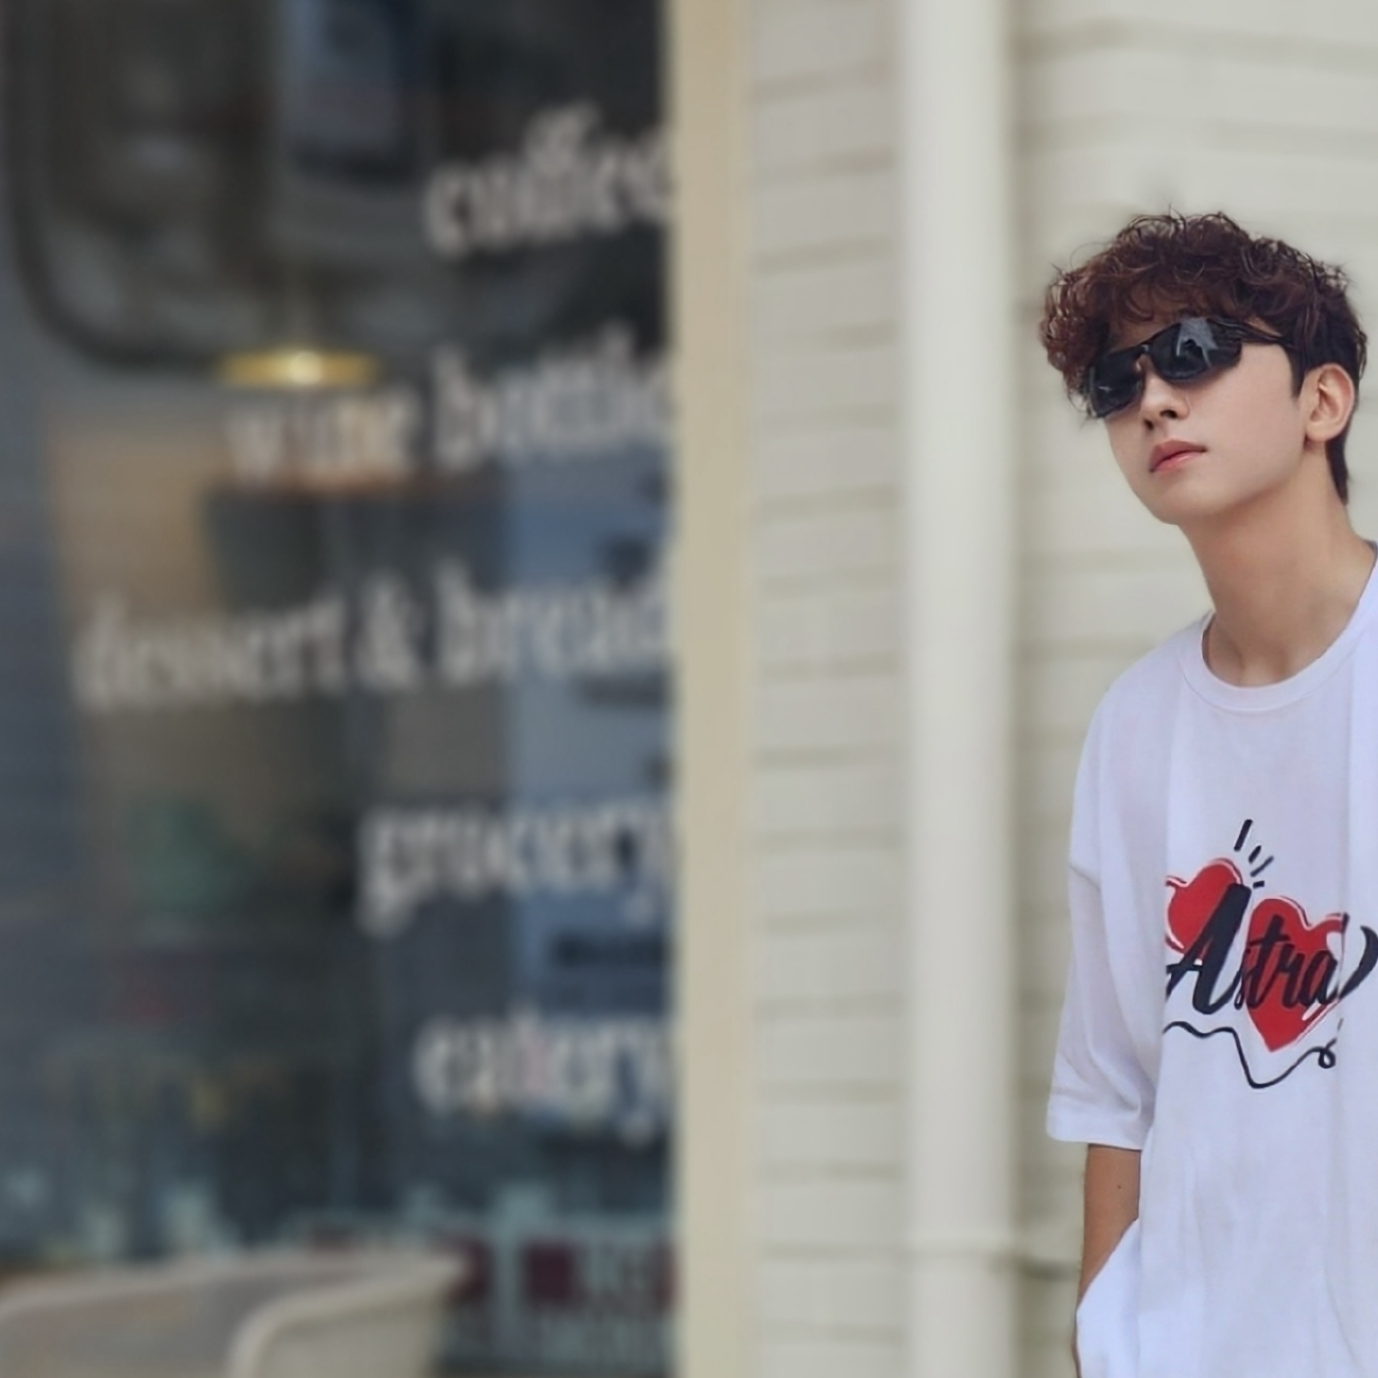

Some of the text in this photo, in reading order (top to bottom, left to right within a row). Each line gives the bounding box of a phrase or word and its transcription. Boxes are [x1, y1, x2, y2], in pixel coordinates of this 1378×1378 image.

[425, 105, 672, 256] coffee
[225, 330, 672, 488] wine bottle
[74, 560, 672, 706] dessert & bread
[358, 803, 674, 936] grocery
[414, 1003, 674, 1144] eatery
